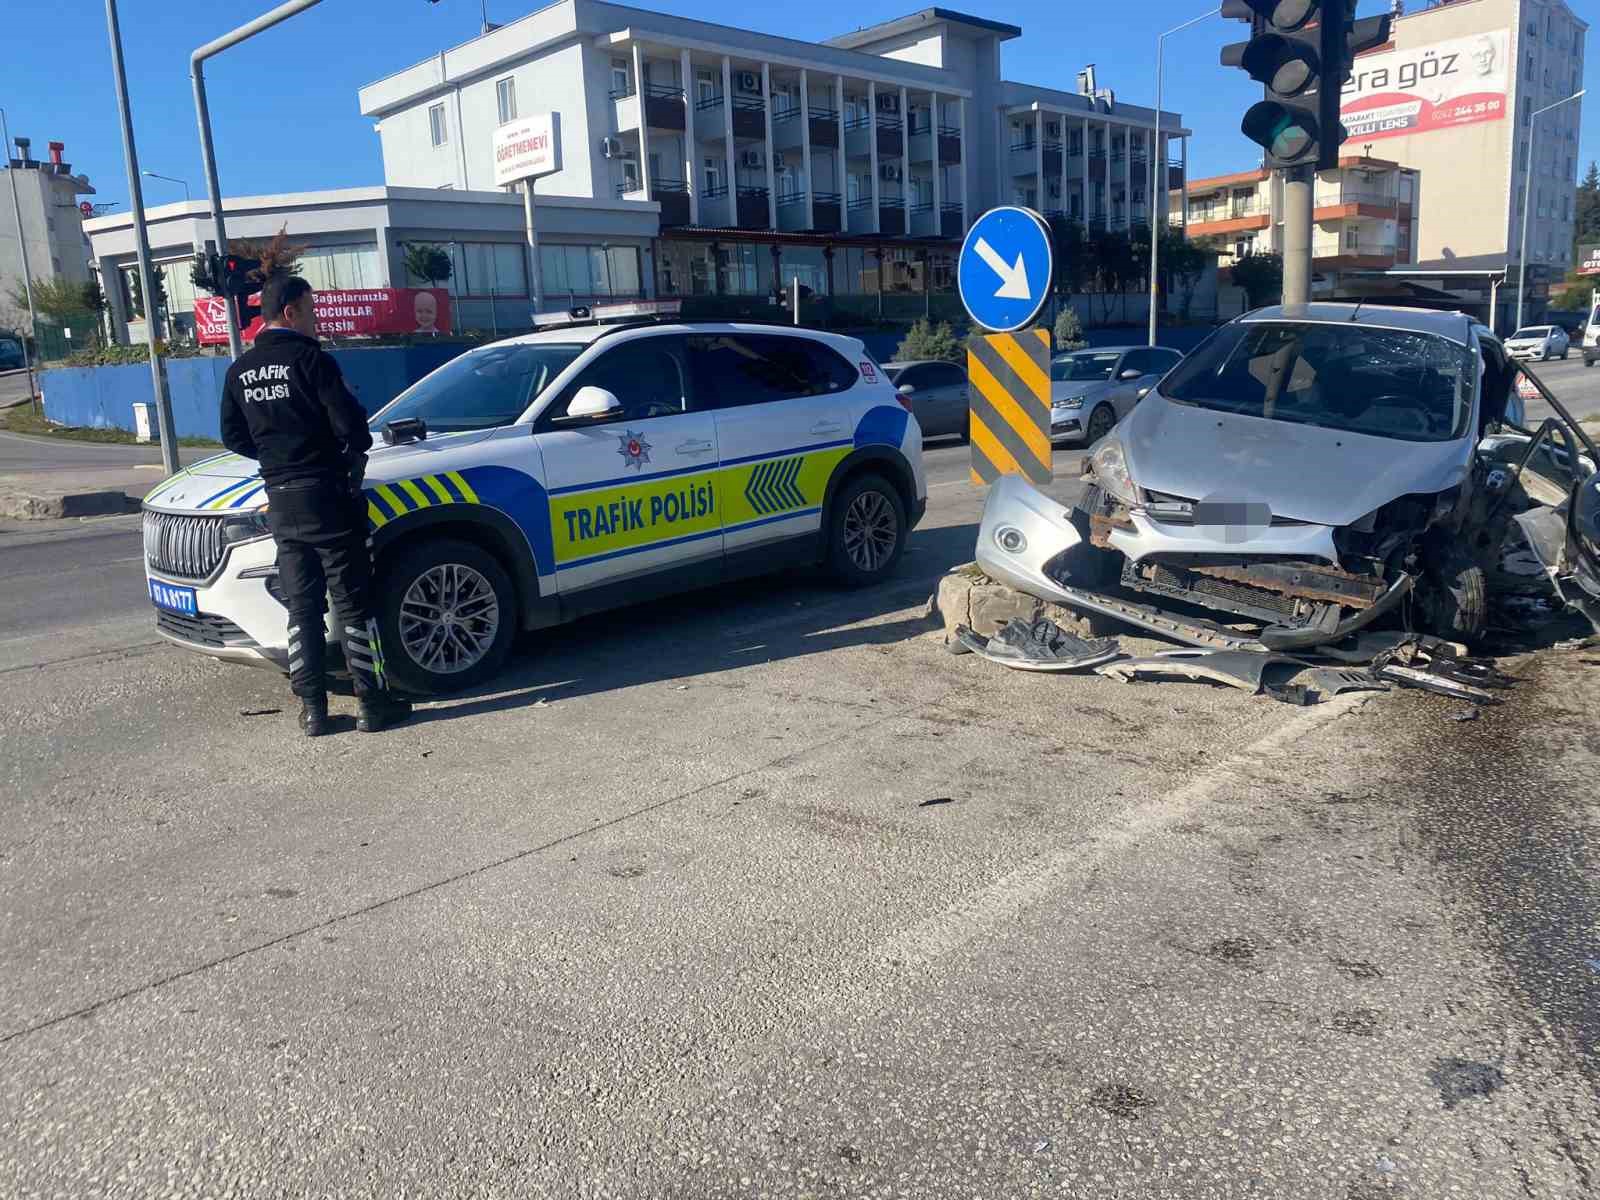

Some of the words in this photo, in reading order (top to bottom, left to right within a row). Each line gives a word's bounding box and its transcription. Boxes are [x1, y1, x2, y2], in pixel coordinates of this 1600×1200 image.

[1339, 67, 1389, 95] era
[1398, 51, 1460, 90] göz
[1380, 116, 1409, 131] LENS
[564, 495, 644, 542] TRAFİK
[650, 480, 714, 526] POLİSİ
